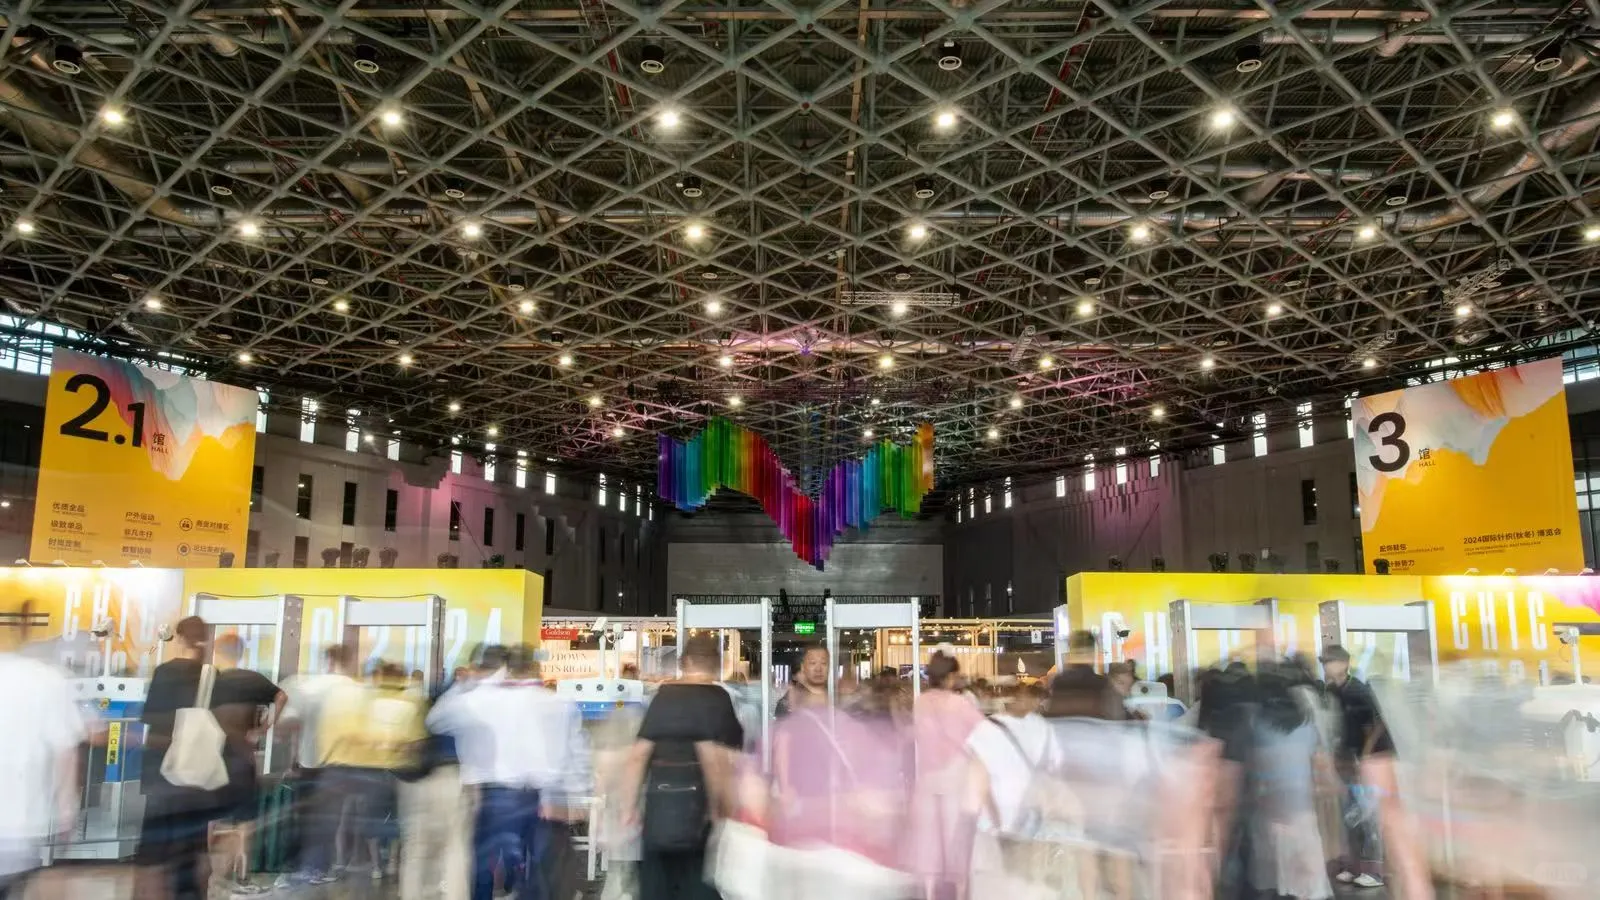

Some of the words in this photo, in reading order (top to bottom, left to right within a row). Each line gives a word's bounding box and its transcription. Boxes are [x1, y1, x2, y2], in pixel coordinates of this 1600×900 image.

[60, 373, 145, 448] 2.1
[153, 432, 165, 446] 馆
[1368, 412, 1410, 472] 3
[151, 446, 168, 454] HALL
[1419, 448, 1431, 460] 馆
[125, 511, 155, 520] 户外运动
[1537, 528, 1561, 537] 博览会
[1450, 591, 1548, 650] CHIC
